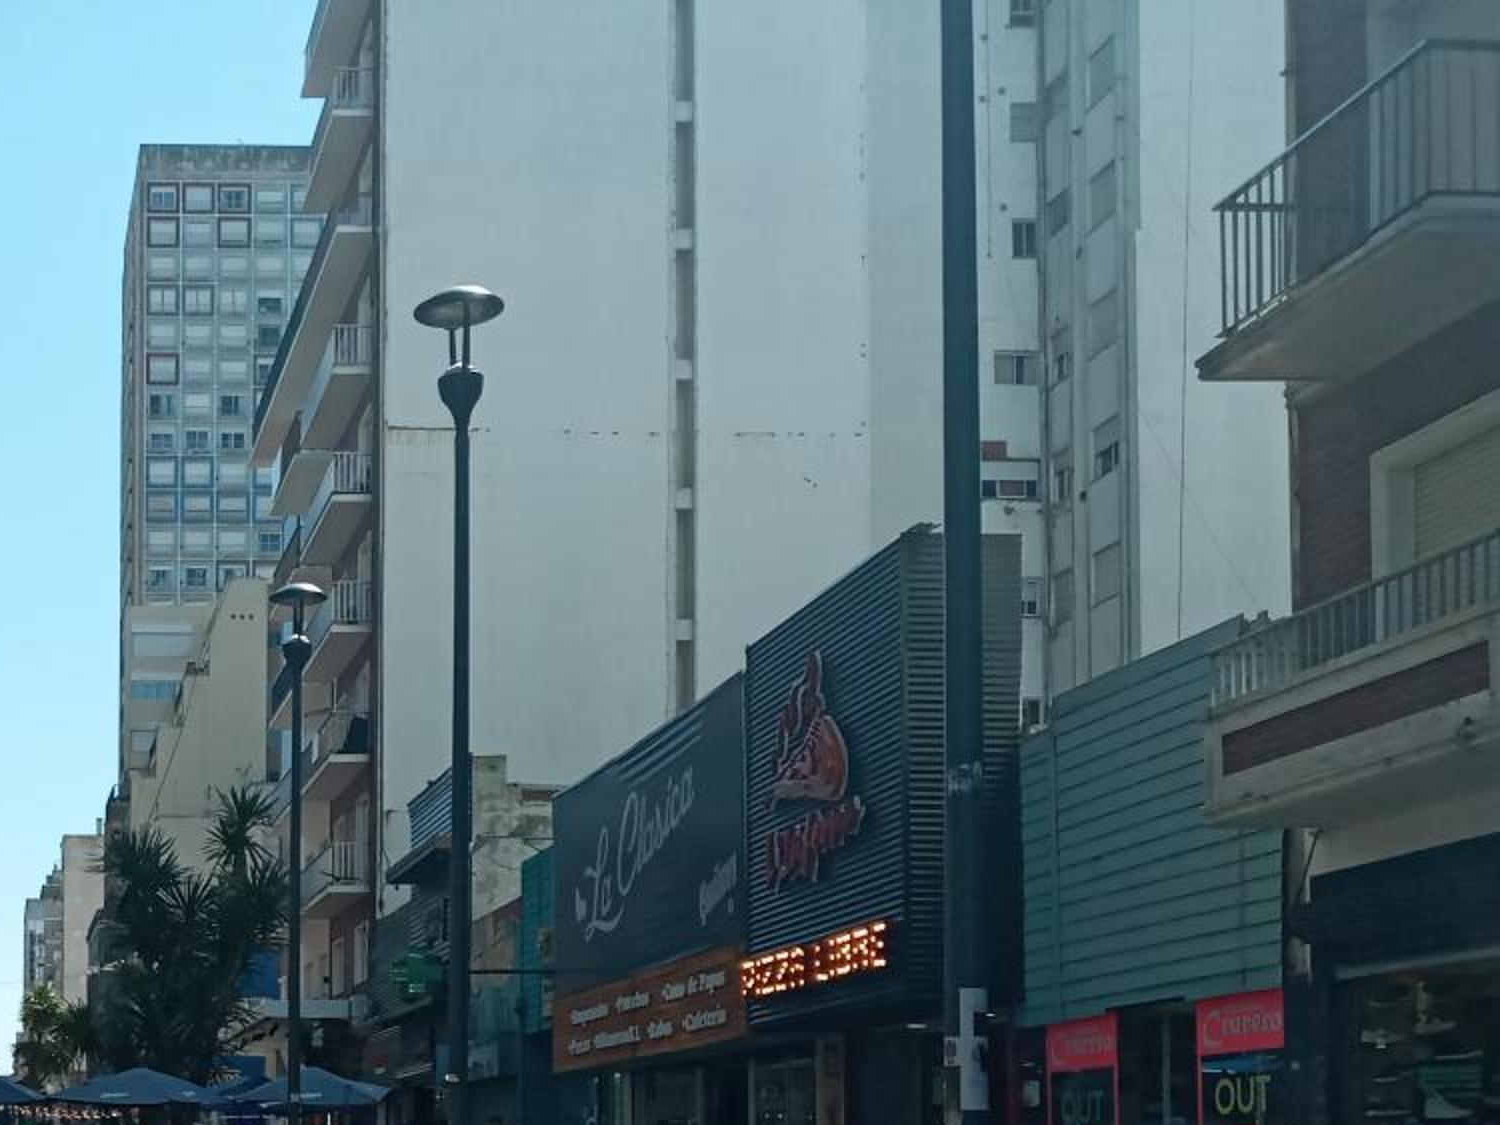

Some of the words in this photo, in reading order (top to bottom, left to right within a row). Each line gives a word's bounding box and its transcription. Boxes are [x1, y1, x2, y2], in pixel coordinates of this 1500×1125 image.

[741, 946, 805, 996] PIZZA
[815, 922, 887, 981] LIBRE
[1059, 1088, 1104, 1122] OUT
[1215, 1074, 1270, 1115] OUT
